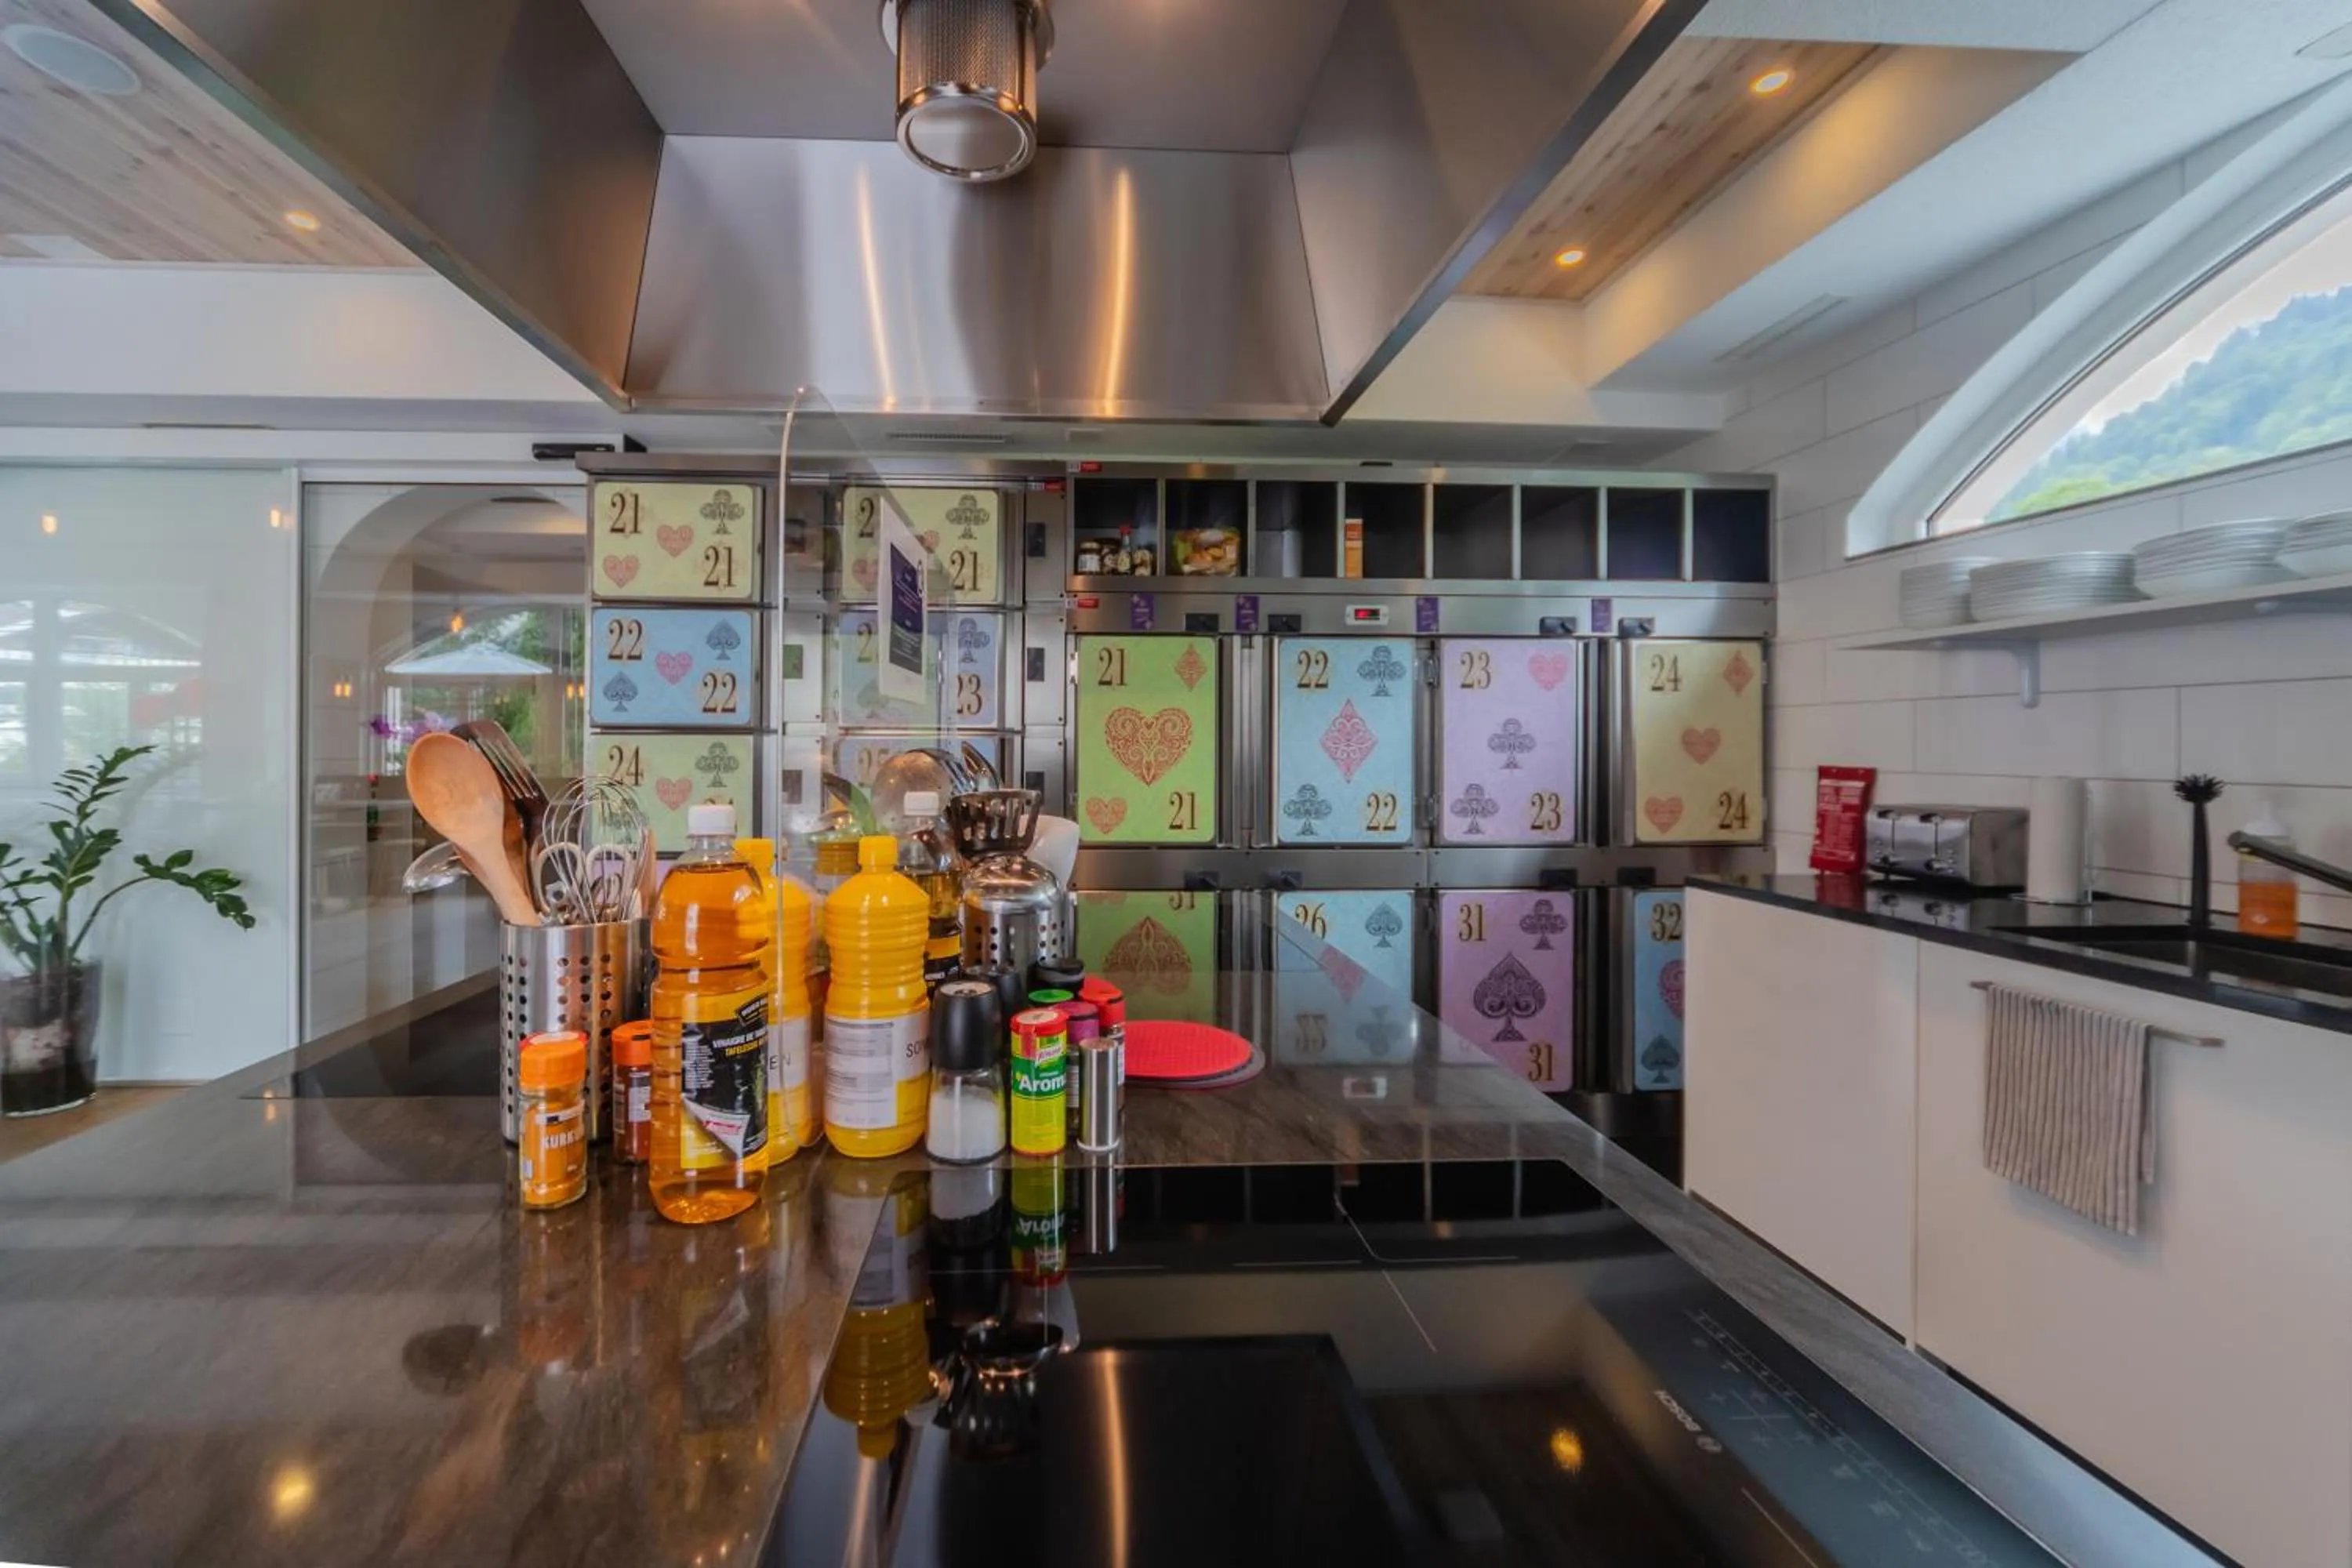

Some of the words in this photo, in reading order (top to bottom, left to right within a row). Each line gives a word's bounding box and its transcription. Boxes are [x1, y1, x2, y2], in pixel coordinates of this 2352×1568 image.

[609, 492, 641, 536] 21
[857, 497, 878, 539] 2
[703, 545, 735, 589] 21
[950, 550, 981, 593] 21
[607, 619, 644, 661] 22
[856, 622, 879, 663] 2
[1098, 647, 1128, 688] 21
[1296, 649, 1330, 690] 22
[1459, 650, 1492, 691] 23
[1650, 652, 1682, 693] 24
[702, 672, 738, 714] 22
[608, 744, 645, 787] 24
[1168, 791, 1199, 831] 21
[1366, 792, 1398, 832] 22
[1530, 792, 1562, 832] 23
[1718, 791, 1750, 832] 24
[1458, 903, 1487, 942] 31
[1651, 902, 1683, 942] 32
[768, 1053, 791, 1071] EN
[1526, 1044, 1555, 1083] 31
[1019, 1074, 1067, 1093] Arom
